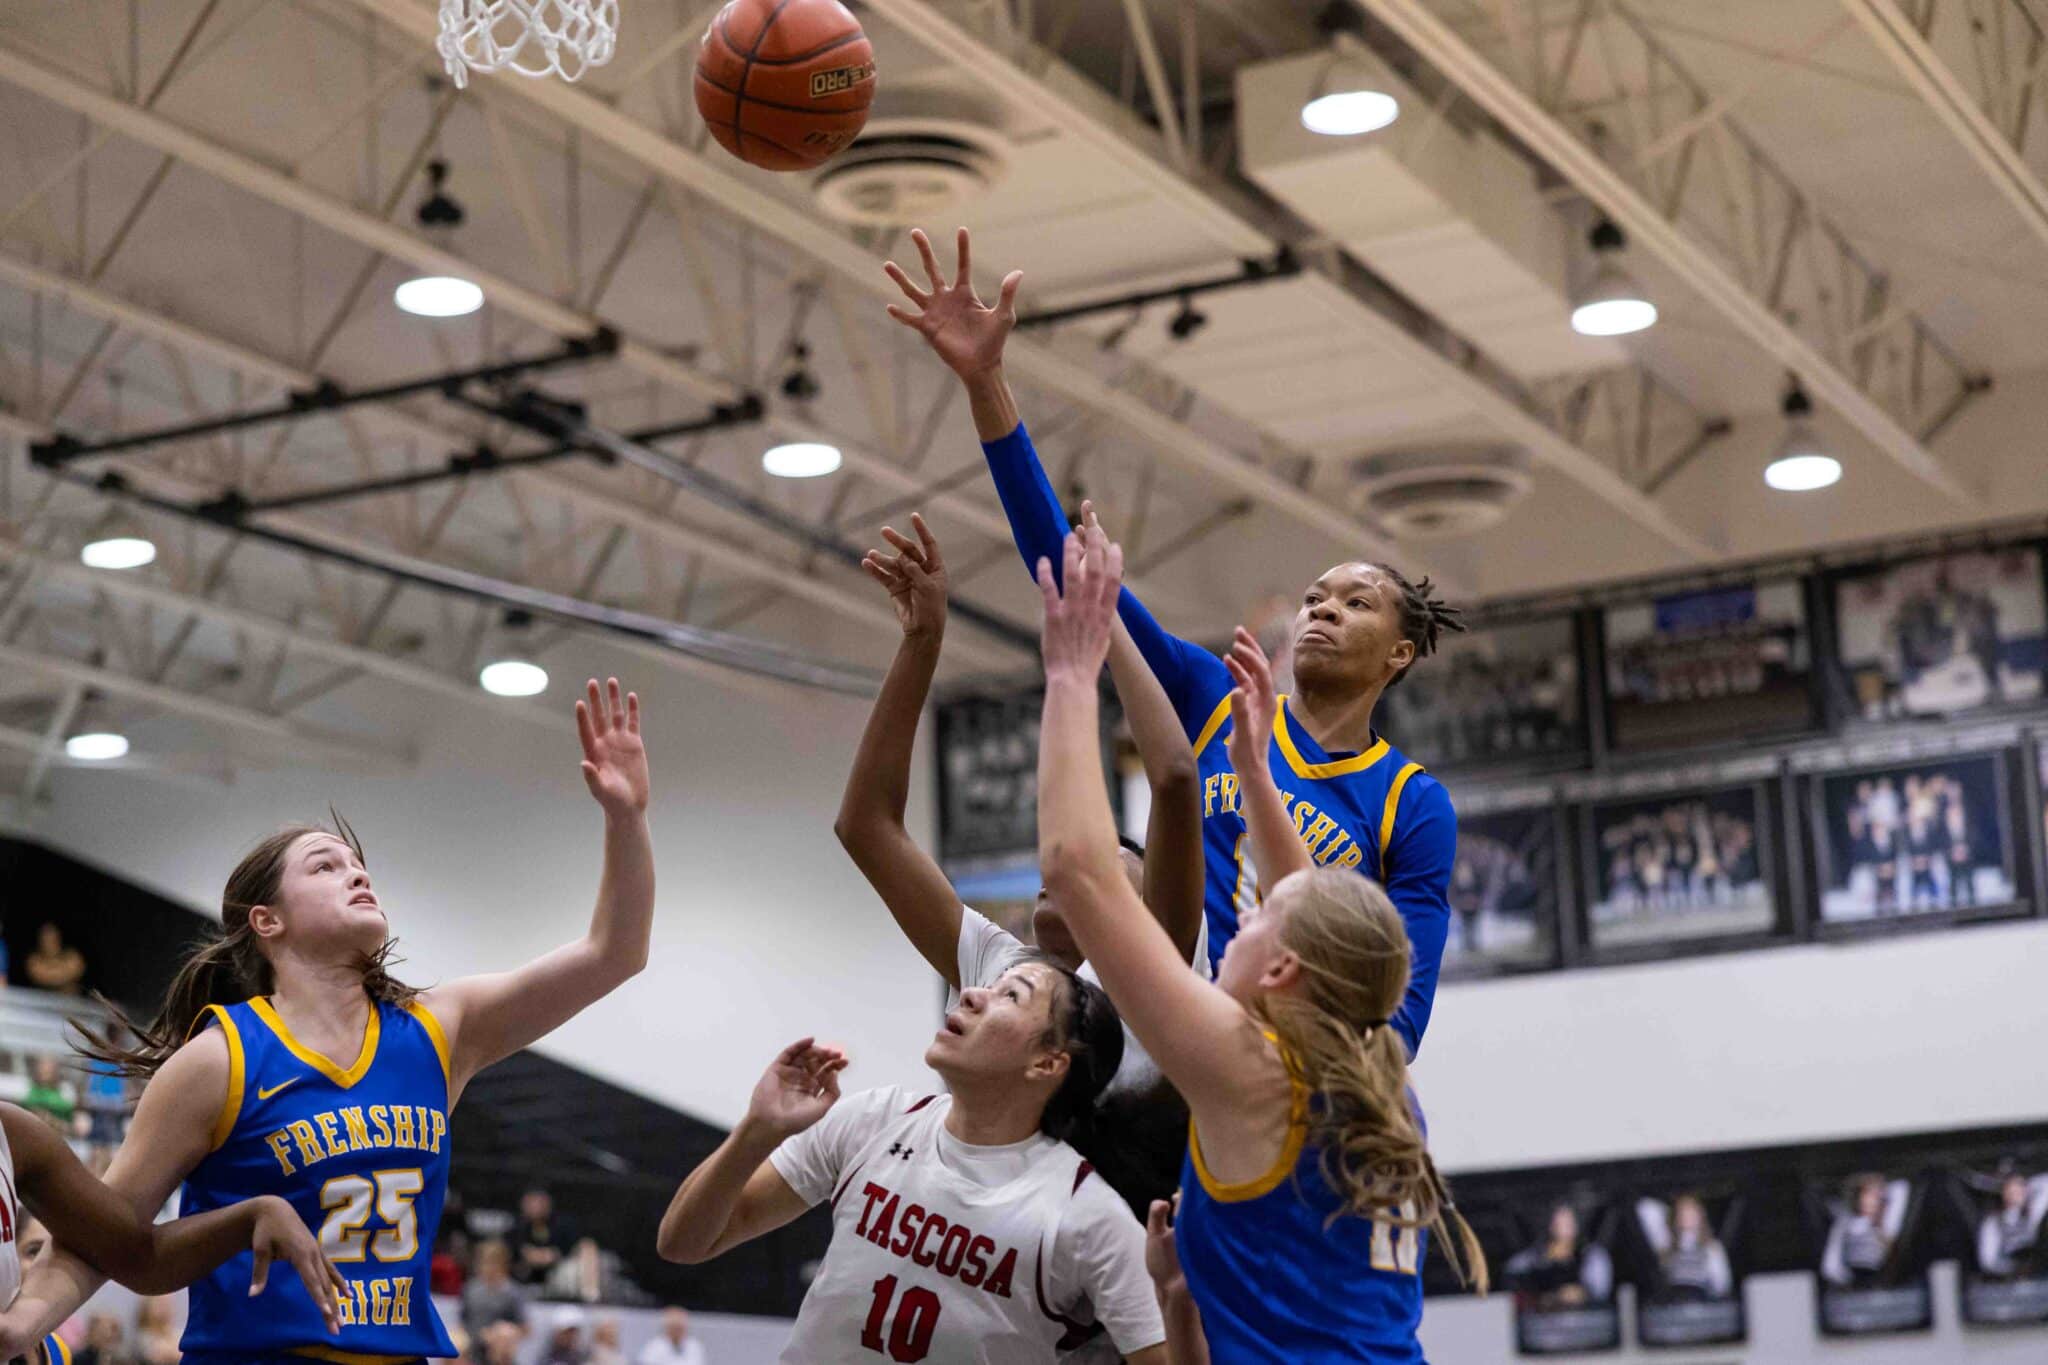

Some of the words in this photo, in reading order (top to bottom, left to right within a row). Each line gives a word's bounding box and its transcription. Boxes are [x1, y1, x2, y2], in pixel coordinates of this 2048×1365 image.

[1204, 772, 1363, 870] FRSHIP
[264, 1105, 447, 1176] FRENSHIP
[317, 1167, 425, 1263] 25
[855, 1181, 1018, 1298] TASCOSA
[332, 1276, 414, 1326] HIGH
[861, 1273, 942, 1364] 10
